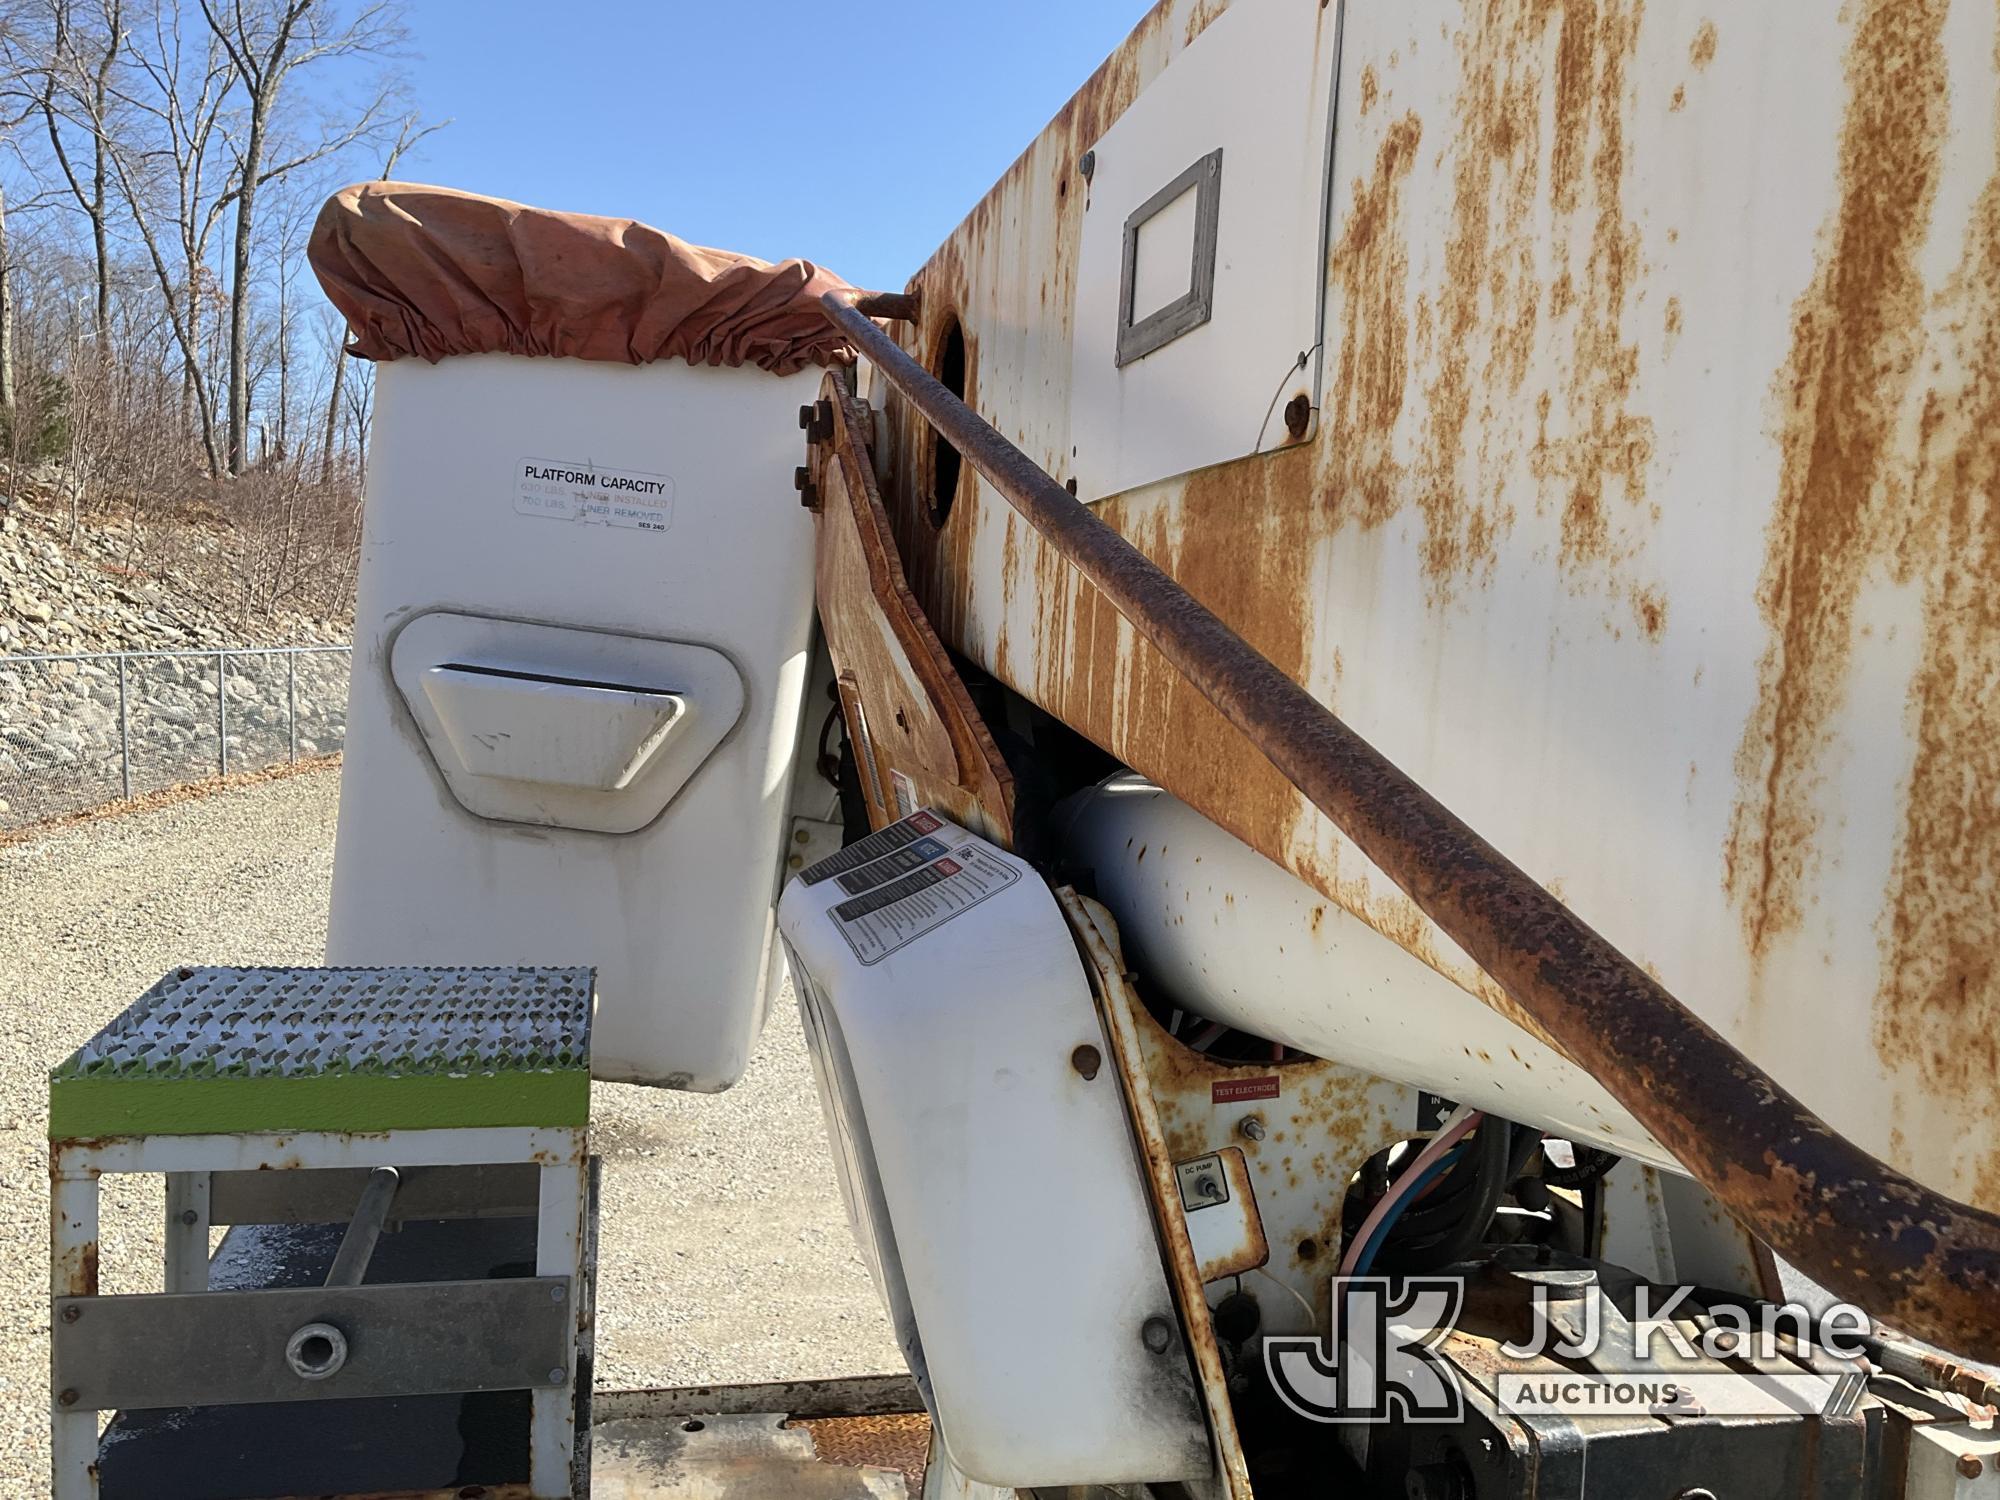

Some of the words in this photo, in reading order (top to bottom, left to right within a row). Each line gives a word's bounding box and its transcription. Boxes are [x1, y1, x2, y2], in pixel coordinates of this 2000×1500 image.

[525, 465, 596, 486] PLATFORM
[601, 476, 665, 495] CAPACITY
[614, 493, 668, 509] INSTALLED
[582, 502, 610, 515] LINER
[614, 507, 664, 521] REMOVED
[1215, 1087, 1234, 1096] TEST
[1235, 1083, 1277, 1095] ELECTRODE
[1431, 1096, 1441, 1105] IN
[1184, 1166, 1195, 1175] DC
[1196, 1162, 1213, 1172] PUMP
